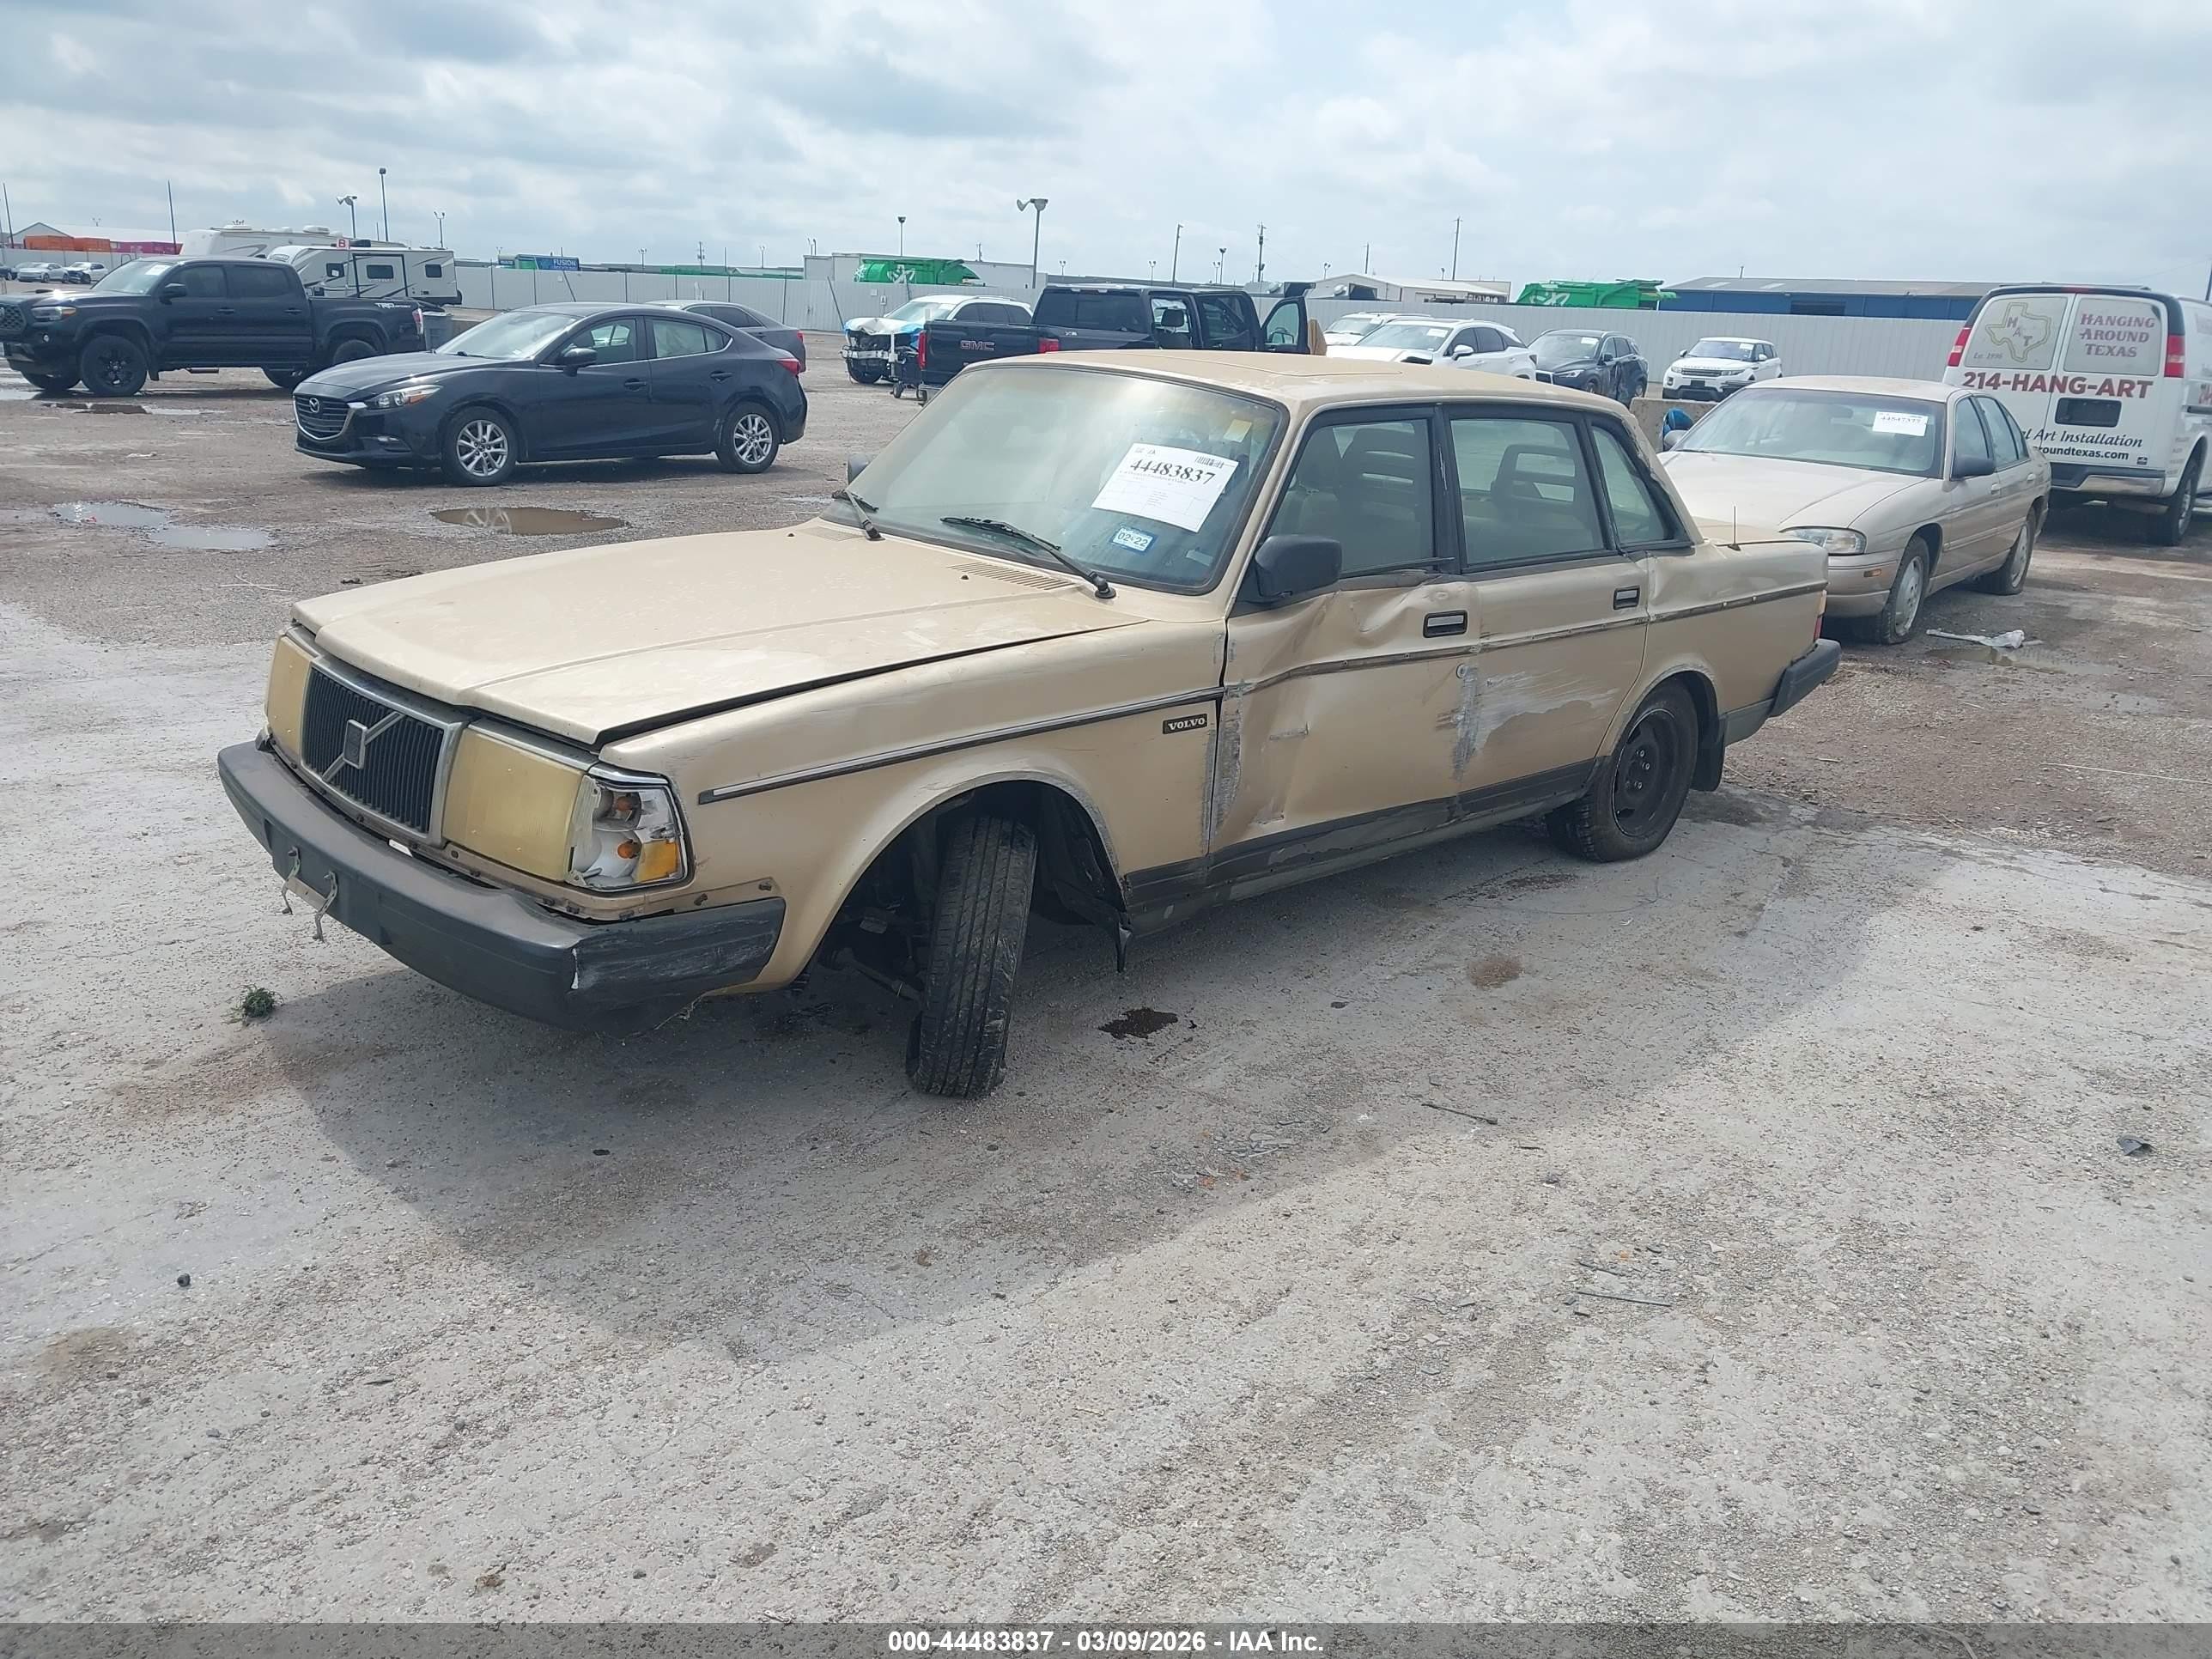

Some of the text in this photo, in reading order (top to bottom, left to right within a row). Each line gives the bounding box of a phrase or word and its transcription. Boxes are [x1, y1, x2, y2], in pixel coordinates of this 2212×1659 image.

[338, 240, 346, 248] B
[2080, 313, 2156, 328] HANGING
[2079, 328, 2149, 343] AROUND
[959, 340, 995, 351] GMC
[2085, 343, 2138, 358] TEXAS
[1963, 371, 2154, 399] 214-HANG-ART
[2033, 428, 2057, 442] Art
[2060, 431, 2143, 447] Installation
[1130, 459, 1216, 484] 44483837
[1117, 532, 1132, 542] 02
[1133, 537, 1149, 547] 22
[1168, 717, 1206, 731] VOLVO
